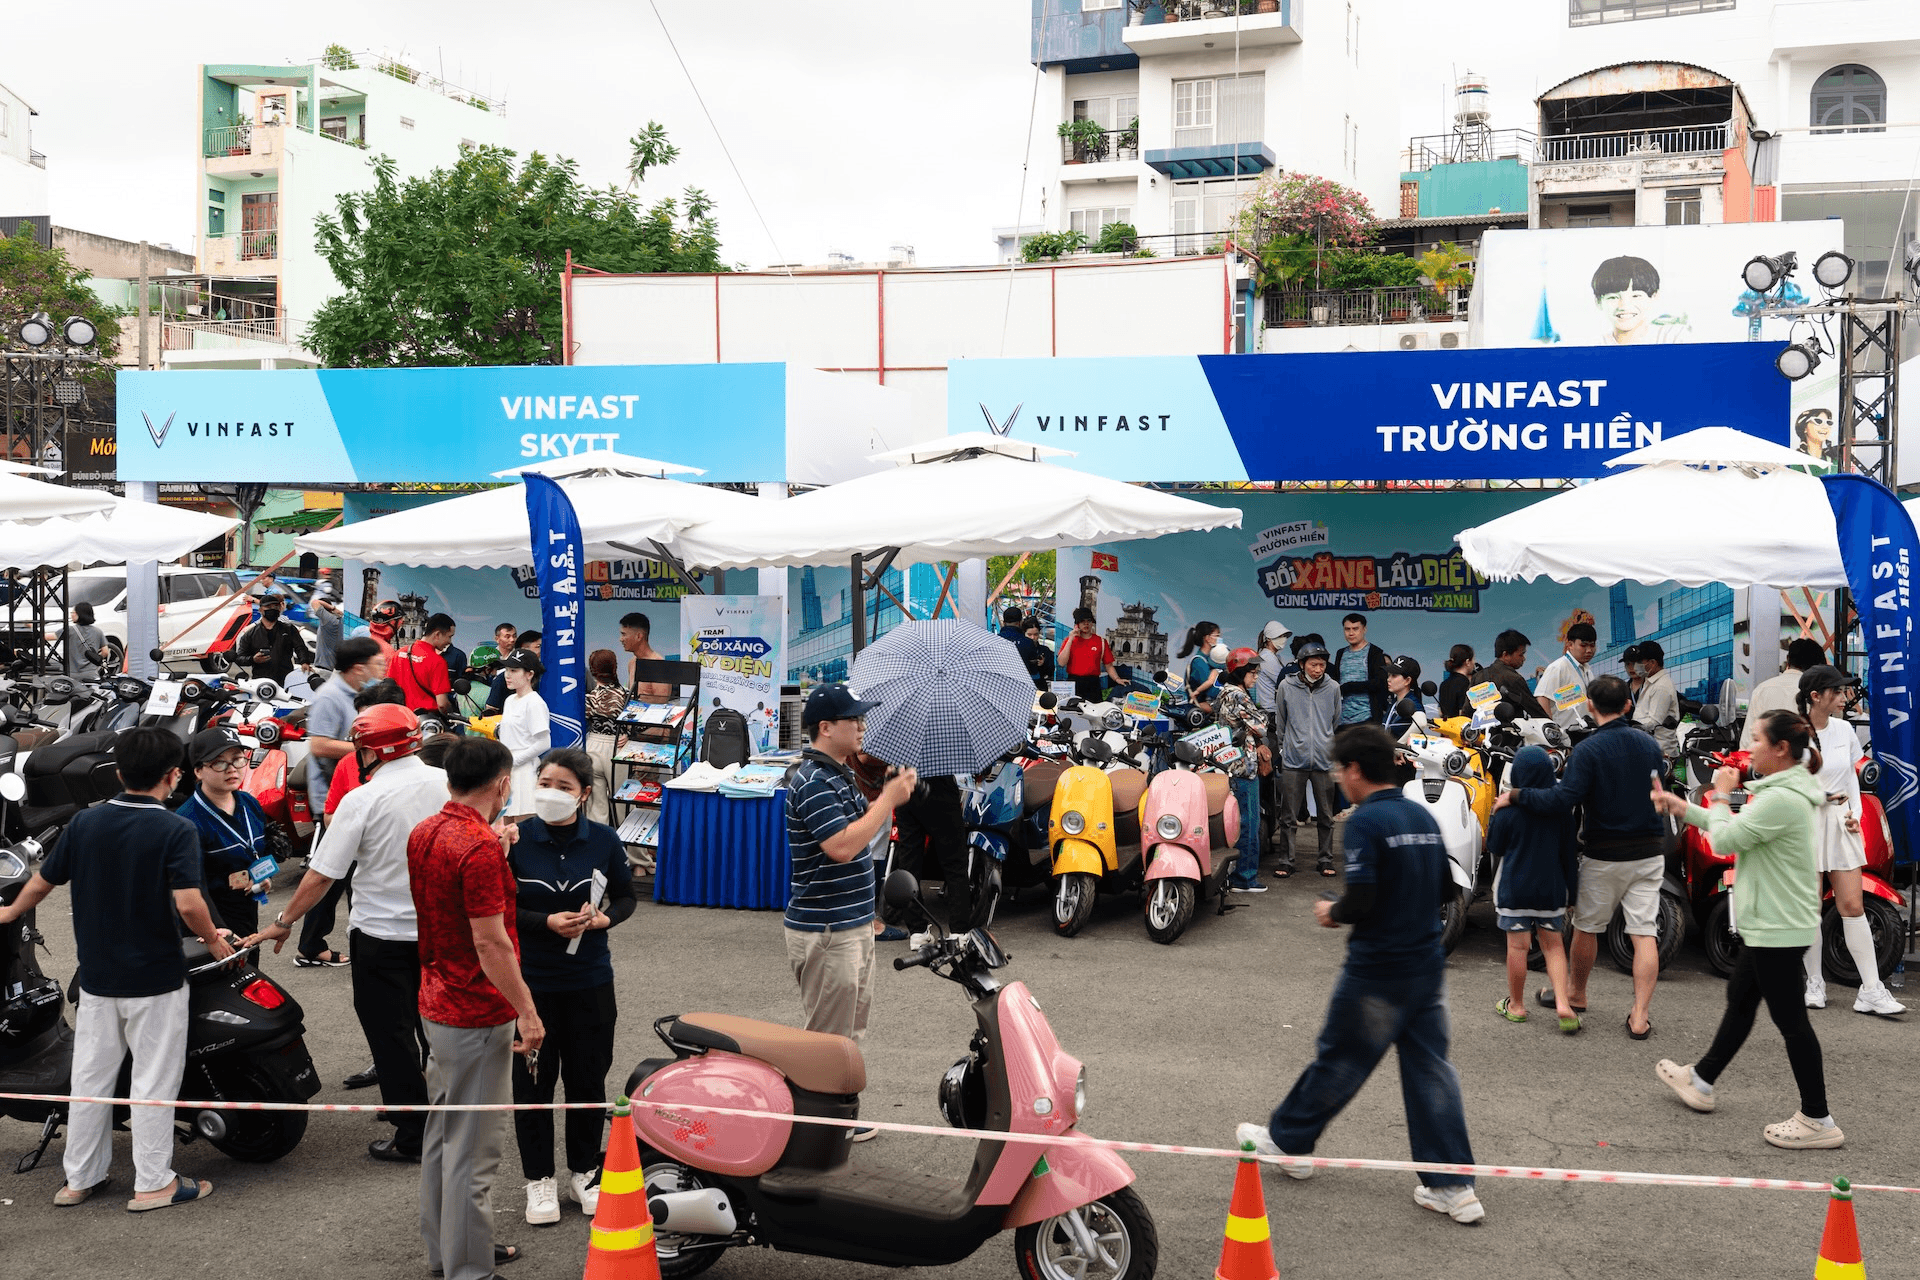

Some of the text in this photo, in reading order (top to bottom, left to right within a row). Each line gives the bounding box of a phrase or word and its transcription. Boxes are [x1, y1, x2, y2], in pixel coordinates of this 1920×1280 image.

[1431, 380, 1607, 410] VINFAST
[500, 395, 640, 419] VINFAST
[187, 422, 295, 437] VINFAST
[1036, 414, 1171, 432] VINFAST
[1376, 412, 1662, 452] TRƯỜNG HIỀN
[1262, 523, 1308, 540] VINFAST
[1253, 537, 1298, 557] TRƯỜNG
[1291, 555, 1376, 590] XĂNG
[1376, 557, 1423, 587] LẤY
[1276, 592, 1309, 607] CÙNG
[1379, 593, 1414, 608] TƯƠNG
[1432, 593, 1473, 608] XANH
[550, 529, 578, 694] VINFAST
[1871, 534, 1910, 730] VINFAST
[702, 638, 764, 653] ĐỔI XĂNG
[720, 655, 772, 678] ĐIỆN
